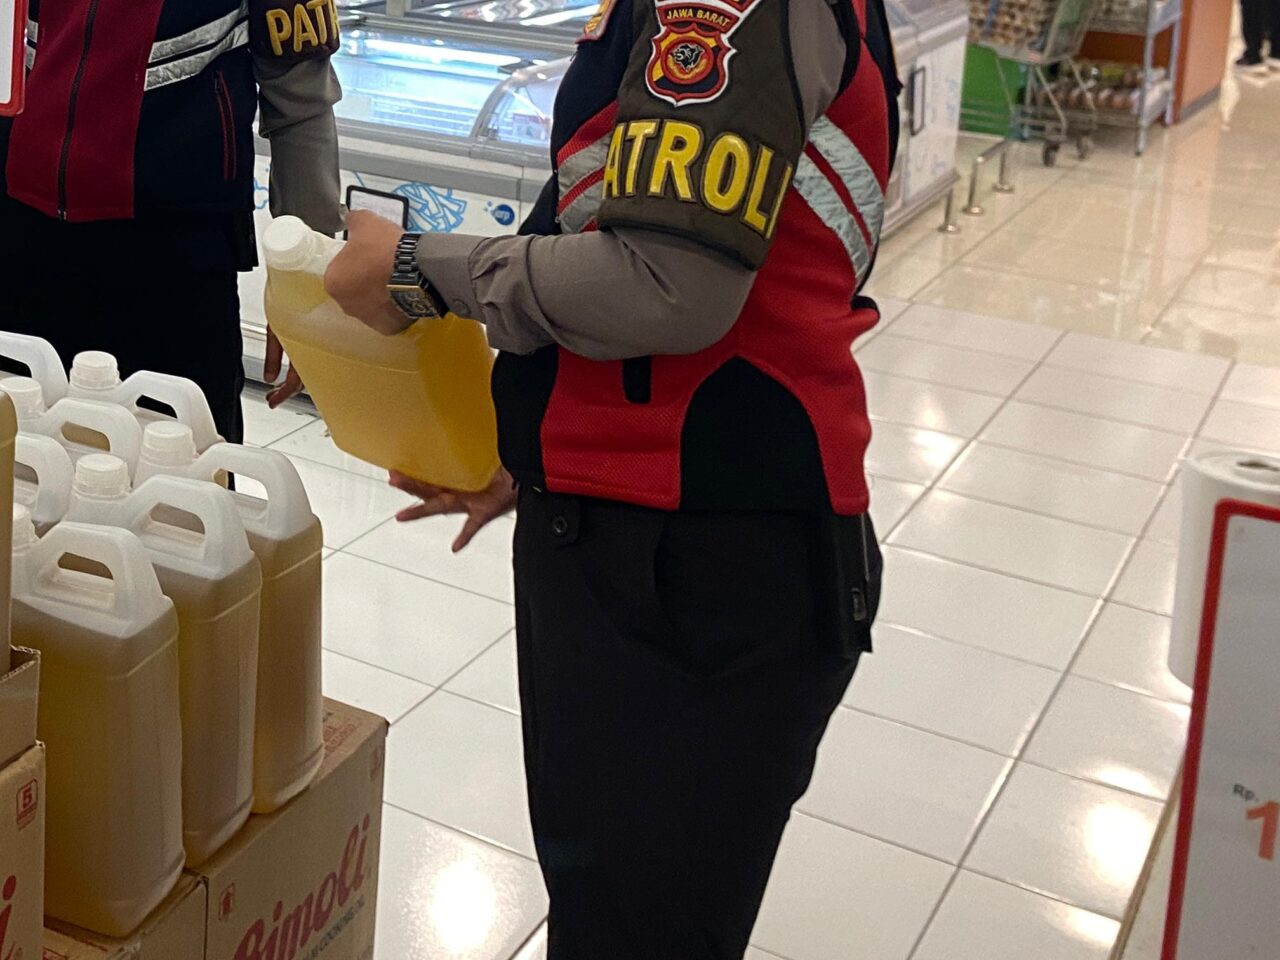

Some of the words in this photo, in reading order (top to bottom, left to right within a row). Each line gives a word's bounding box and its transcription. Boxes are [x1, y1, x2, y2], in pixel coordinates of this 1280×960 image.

[666, 8, 695, 21] JAWA
[696, 9, 729, 28] BARAT
[21, 785, 34, 807] 5
[232, 812, 371, 960] Bimoli
